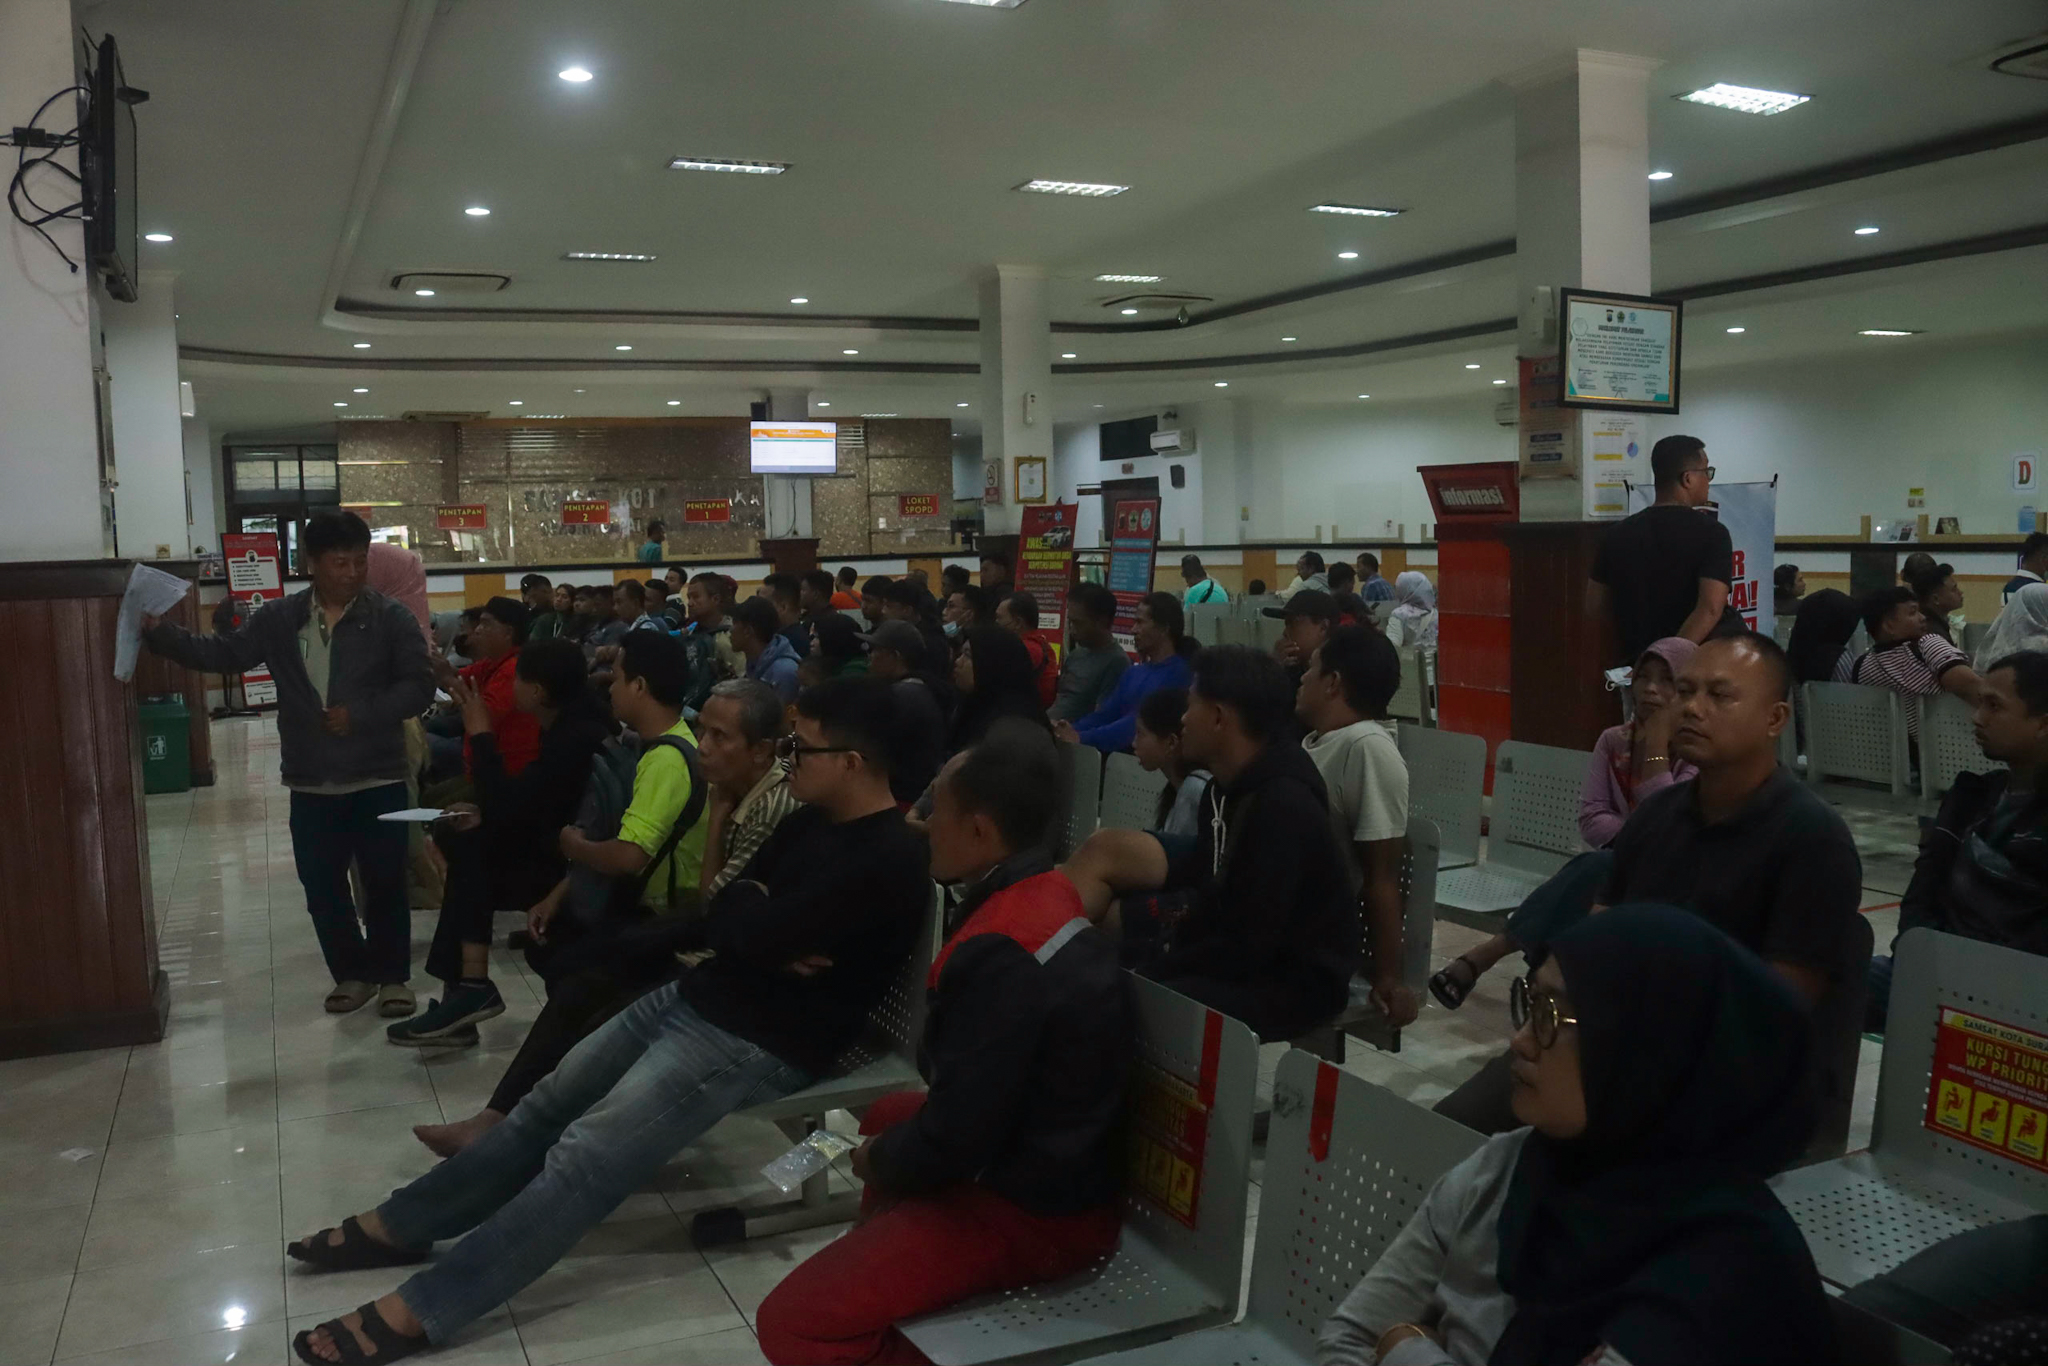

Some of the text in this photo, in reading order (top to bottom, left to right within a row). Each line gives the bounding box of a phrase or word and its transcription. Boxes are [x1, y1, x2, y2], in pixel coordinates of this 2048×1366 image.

[2019, 460, 2031, 484] D
[906, 496, 930, 505] LOKET
[1438, 485, 1505, 506] informasi
[564, 504, 606, 512] PENETAPAN
[686, 502, 726, 510] PENETAPAN
[904, 505, 933, 514] SPOPD
[438, 508, 482, 516] PENETAPAN
[582, 512, 589, 522] 2
[704, 511, 710, 520] 1
[457, 516, 465, 526] 3
[1963, 1019, 1997, 1035] SAMSAT
[2000, 1030, 2023, 1043] KOTA
[1966, 1036, 2009, 1062] KURSI
[1965, 1052, 1987, 1070] WP
